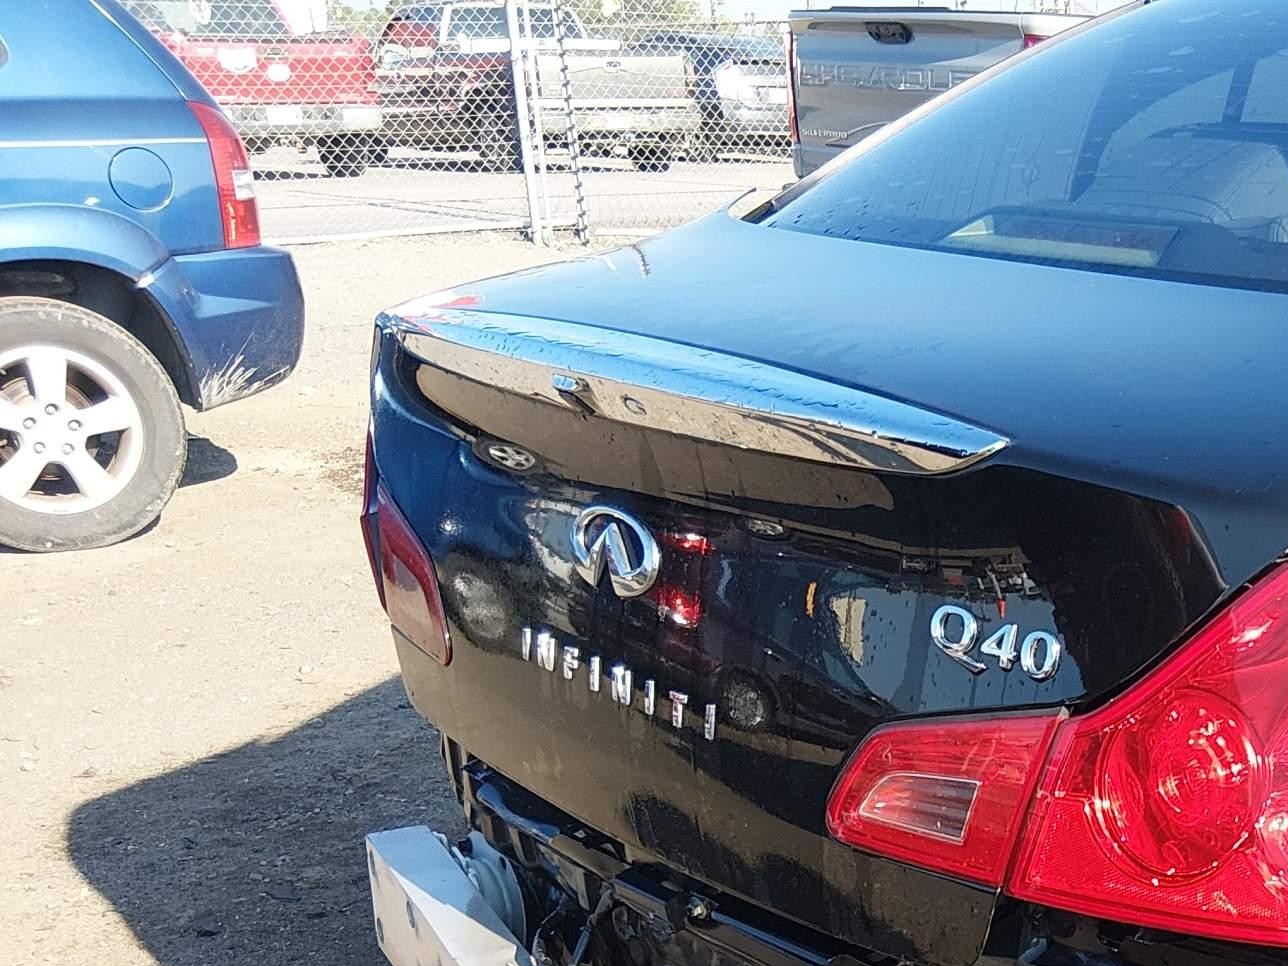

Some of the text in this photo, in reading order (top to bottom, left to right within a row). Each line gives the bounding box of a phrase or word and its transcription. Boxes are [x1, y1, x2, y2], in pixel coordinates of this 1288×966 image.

[800, 64, 975, 91] CHEVROLE
[930, 605, 1061, 679] Q40
[521, 627, 717, 741] INFINITI
